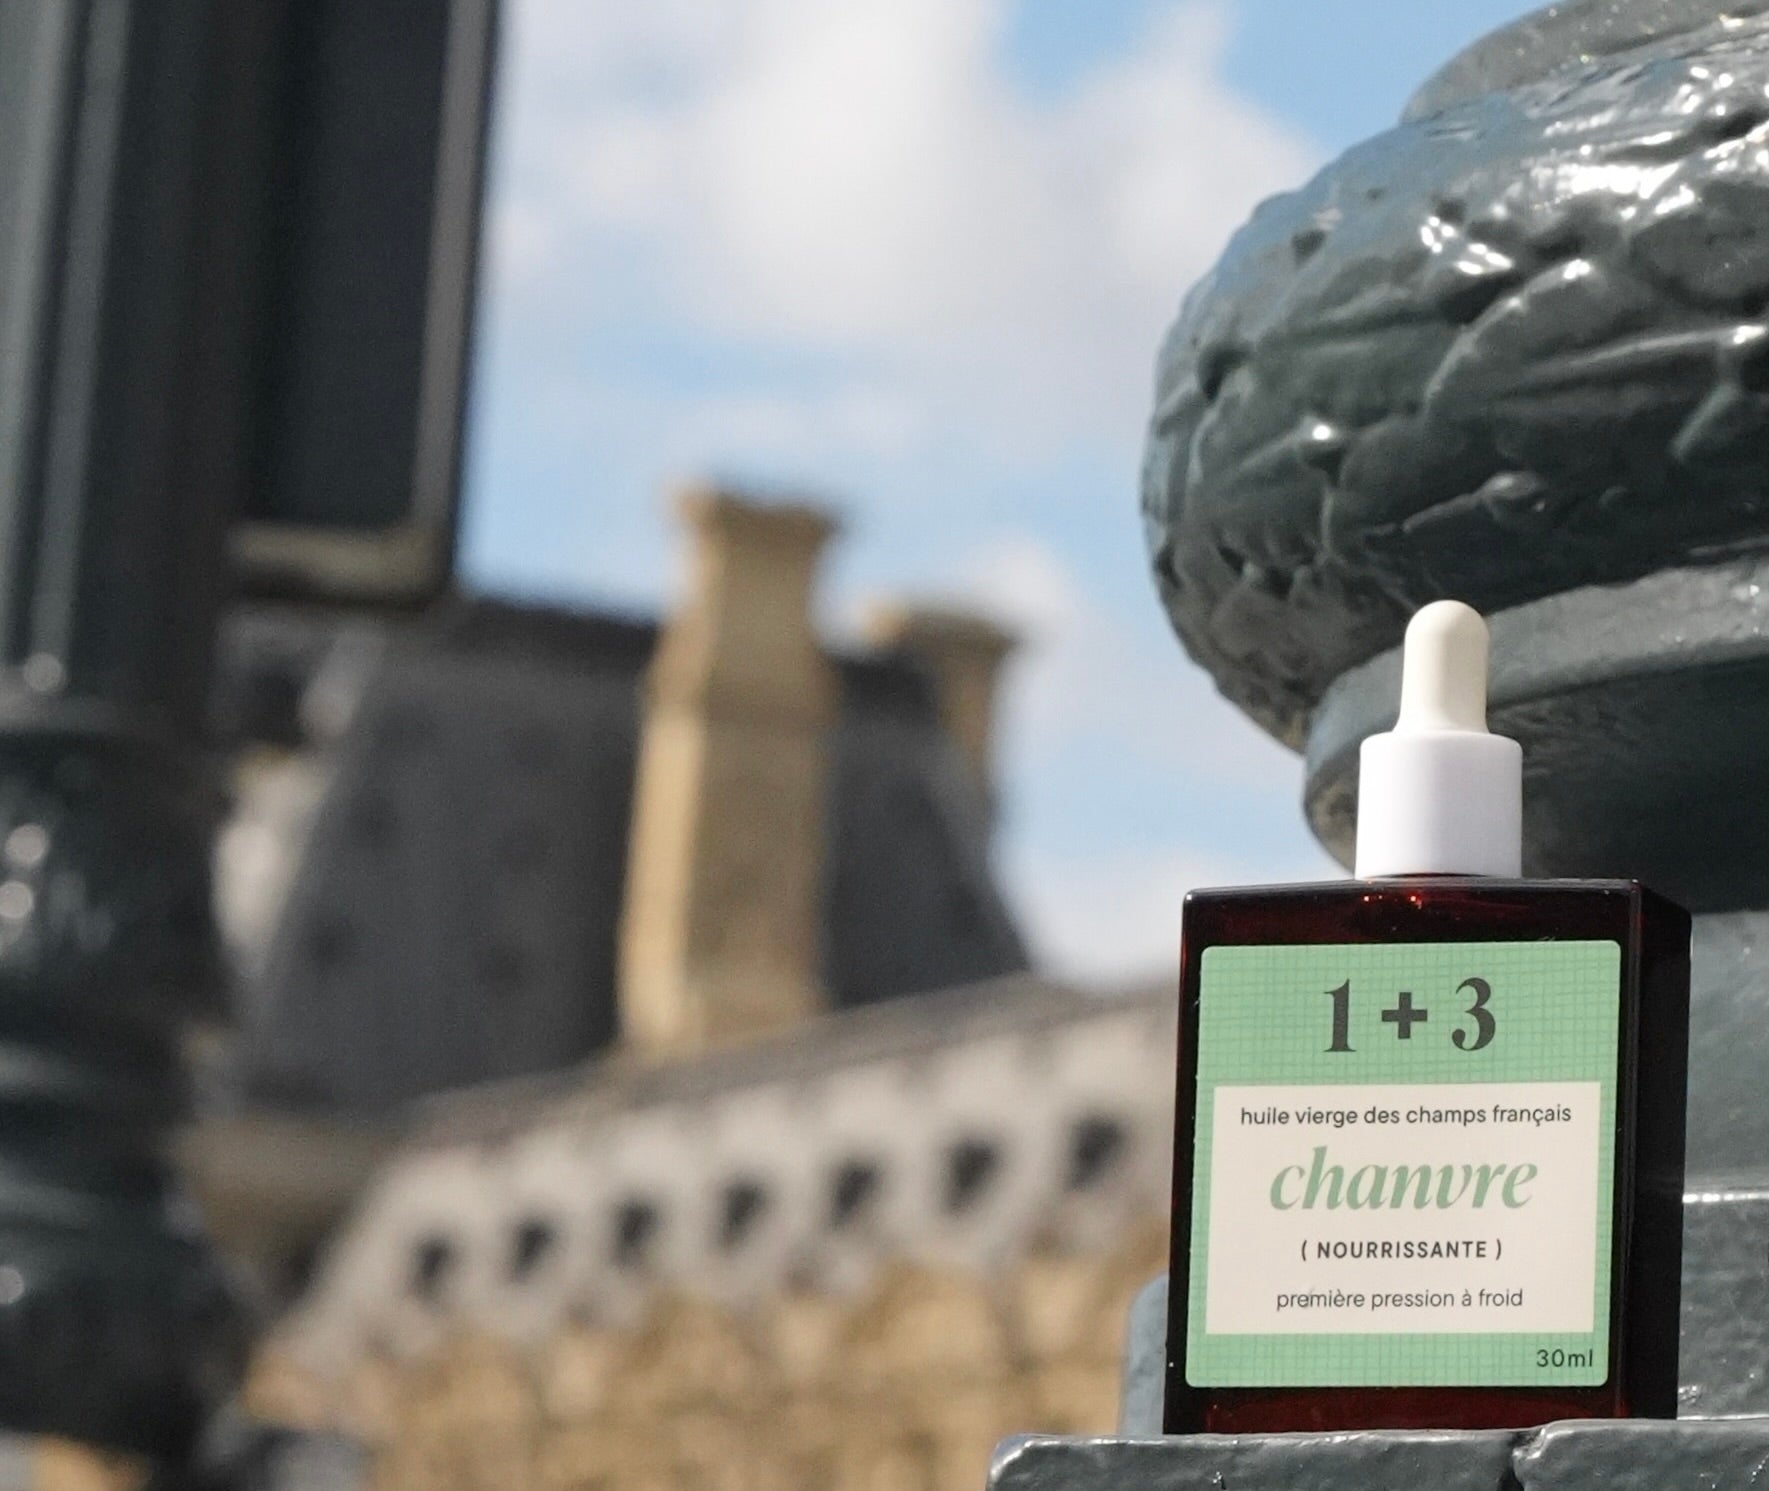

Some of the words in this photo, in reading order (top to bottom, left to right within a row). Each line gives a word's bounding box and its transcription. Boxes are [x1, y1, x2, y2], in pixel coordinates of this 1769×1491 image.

[1323, 978, 1357, 1053] 1
[1381, 991, 1428, 1040] +
[1451, 977, 1496, 1052] 3
[1240, 1106, 1291, 1126] huile
[1297, 1105, 1359, 1129] vierge
[1363, 1105, 1401, 1125] des
[1405, 1104, 1487, 1128] champs
[1491, 1103, 1572, 1128] français
[1269, 1145, 1538, 1211] chanvre
[1276, 1288, 1366, 1313] première
[1370, 1288, 1455, 1313] pression
[1460, 1288, 1473, 1308] à
[1477, 1287, 1524, 1308] froid
[1536, 1348, 1594, 1368] 30ml
